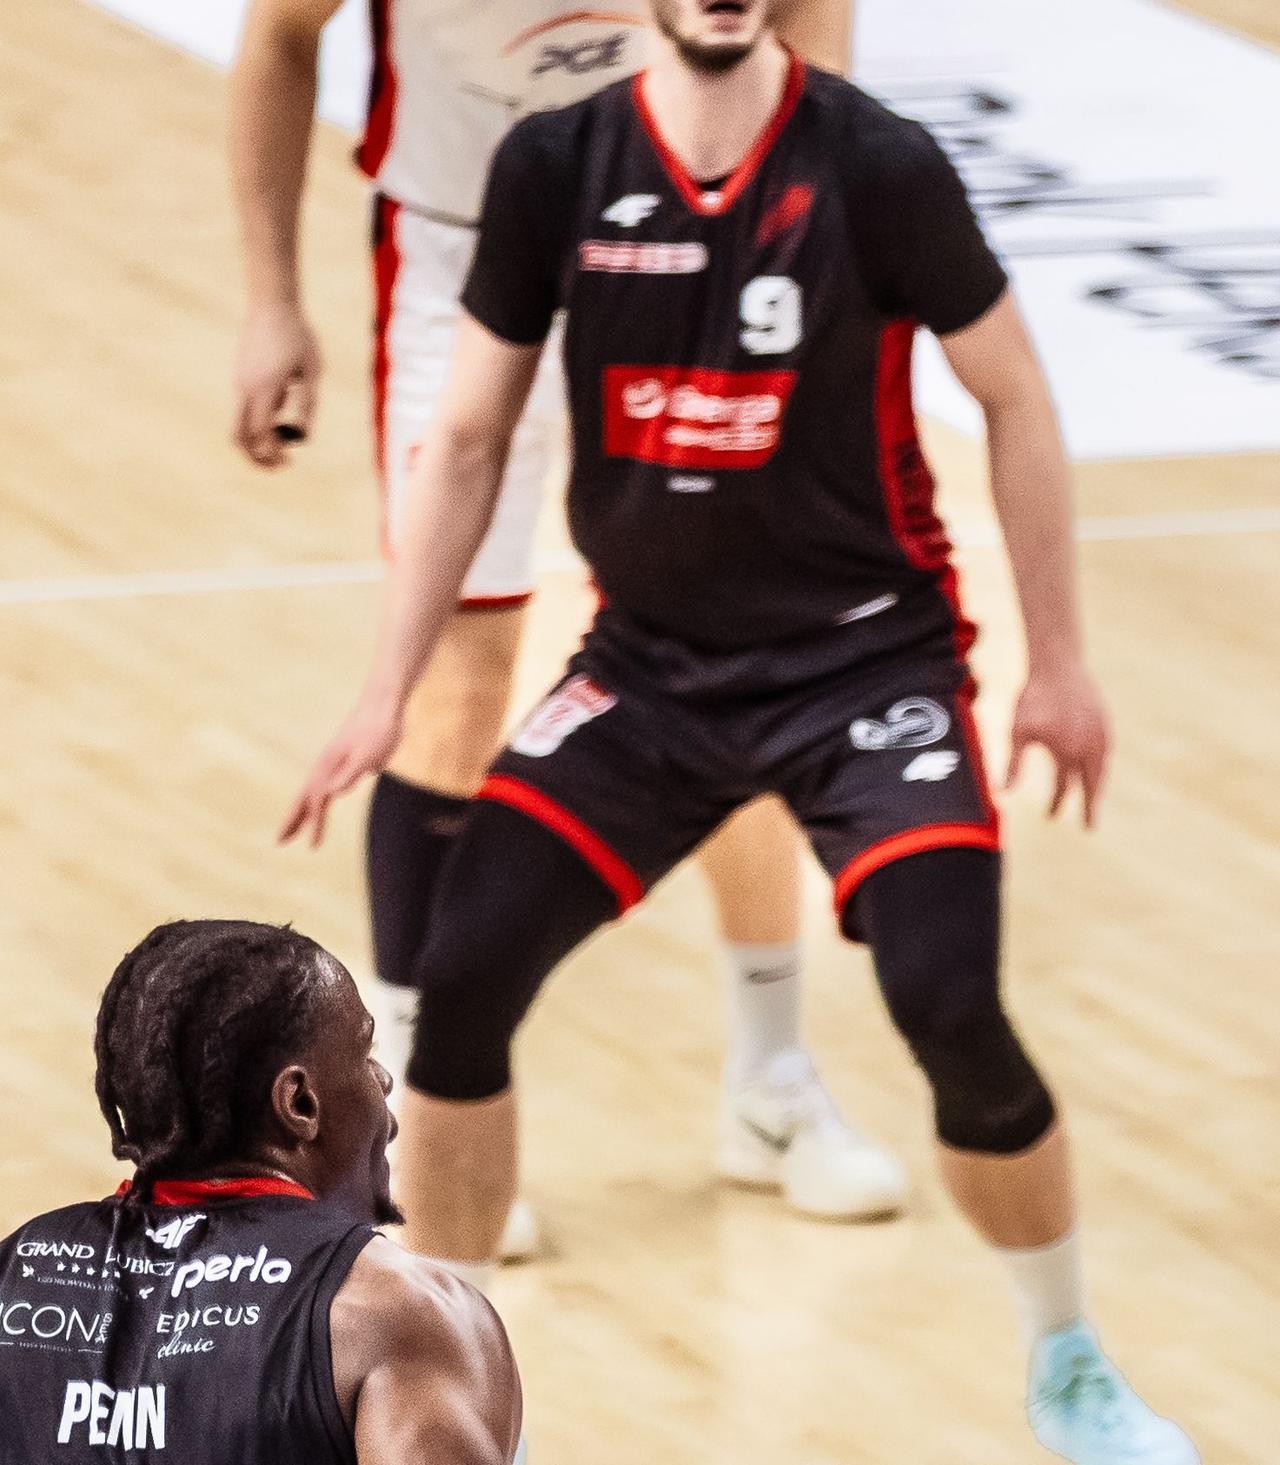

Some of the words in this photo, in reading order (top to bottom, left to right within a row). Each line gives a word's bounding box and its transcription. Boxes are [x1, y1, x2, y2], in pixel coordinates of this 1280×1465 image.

[740, 274, 802, 354] 9
[17, 1242, 95, 1259] GRAND
[156, 1305, 261, 1334] EDICUS
